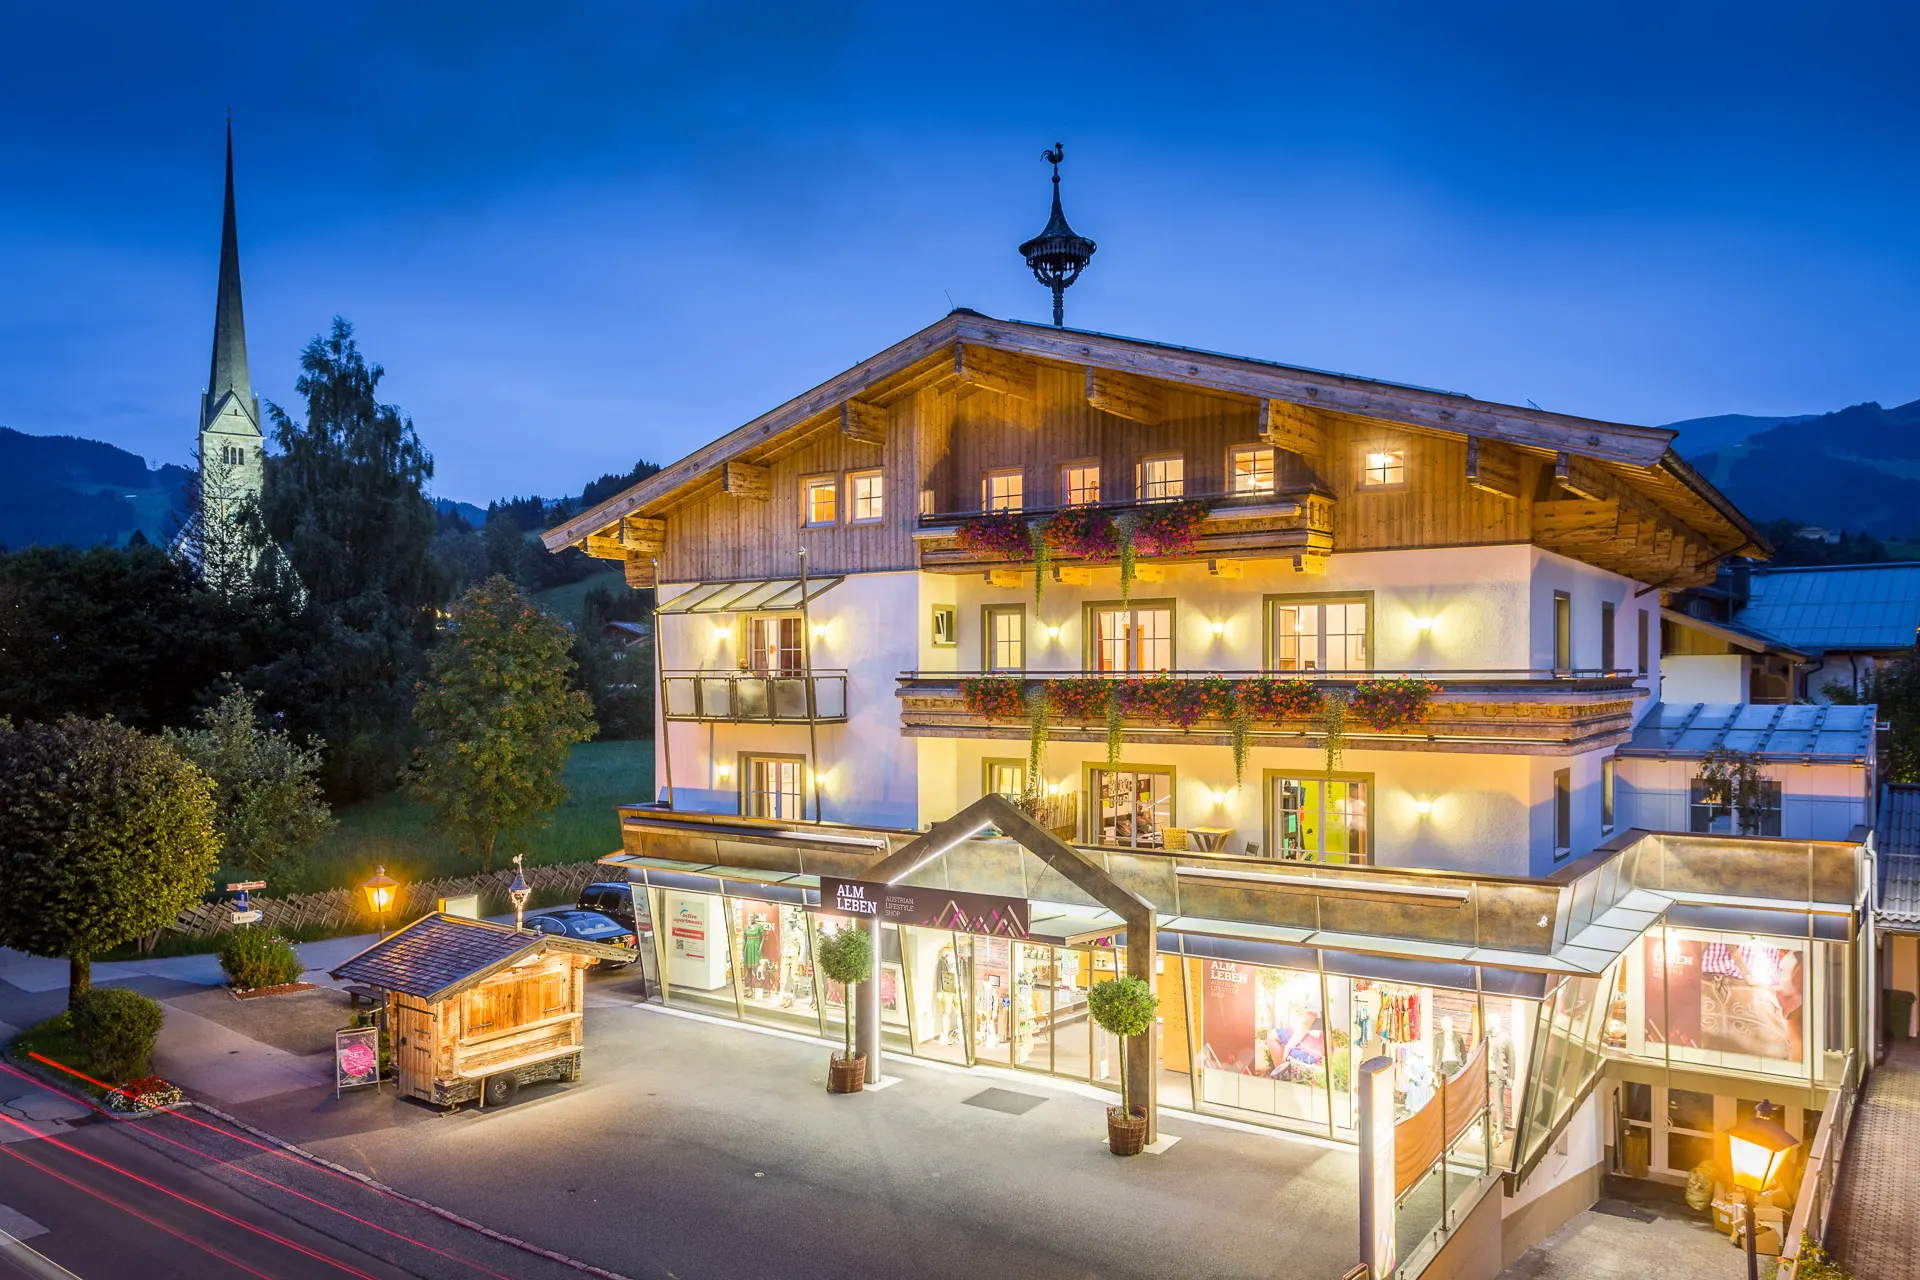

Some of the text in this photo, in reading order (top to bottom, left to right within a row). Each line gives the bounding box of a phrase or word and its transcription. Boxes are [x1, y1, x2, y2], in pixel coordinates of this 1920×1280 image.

[836, 884, 864, 899] ALM
[885, 895, 914, 905] AUSTRIAN
[836, 897, 878, 914] LEBEN
[885, 902, 914, 912] LIFESTYLE
[885, 909, 901, 917] SHOP
[1211, 961, 1235, 972] ALM
[1211, 970, 1247, 984] LEBEN
[348, 1050, 364, 1058] SET
